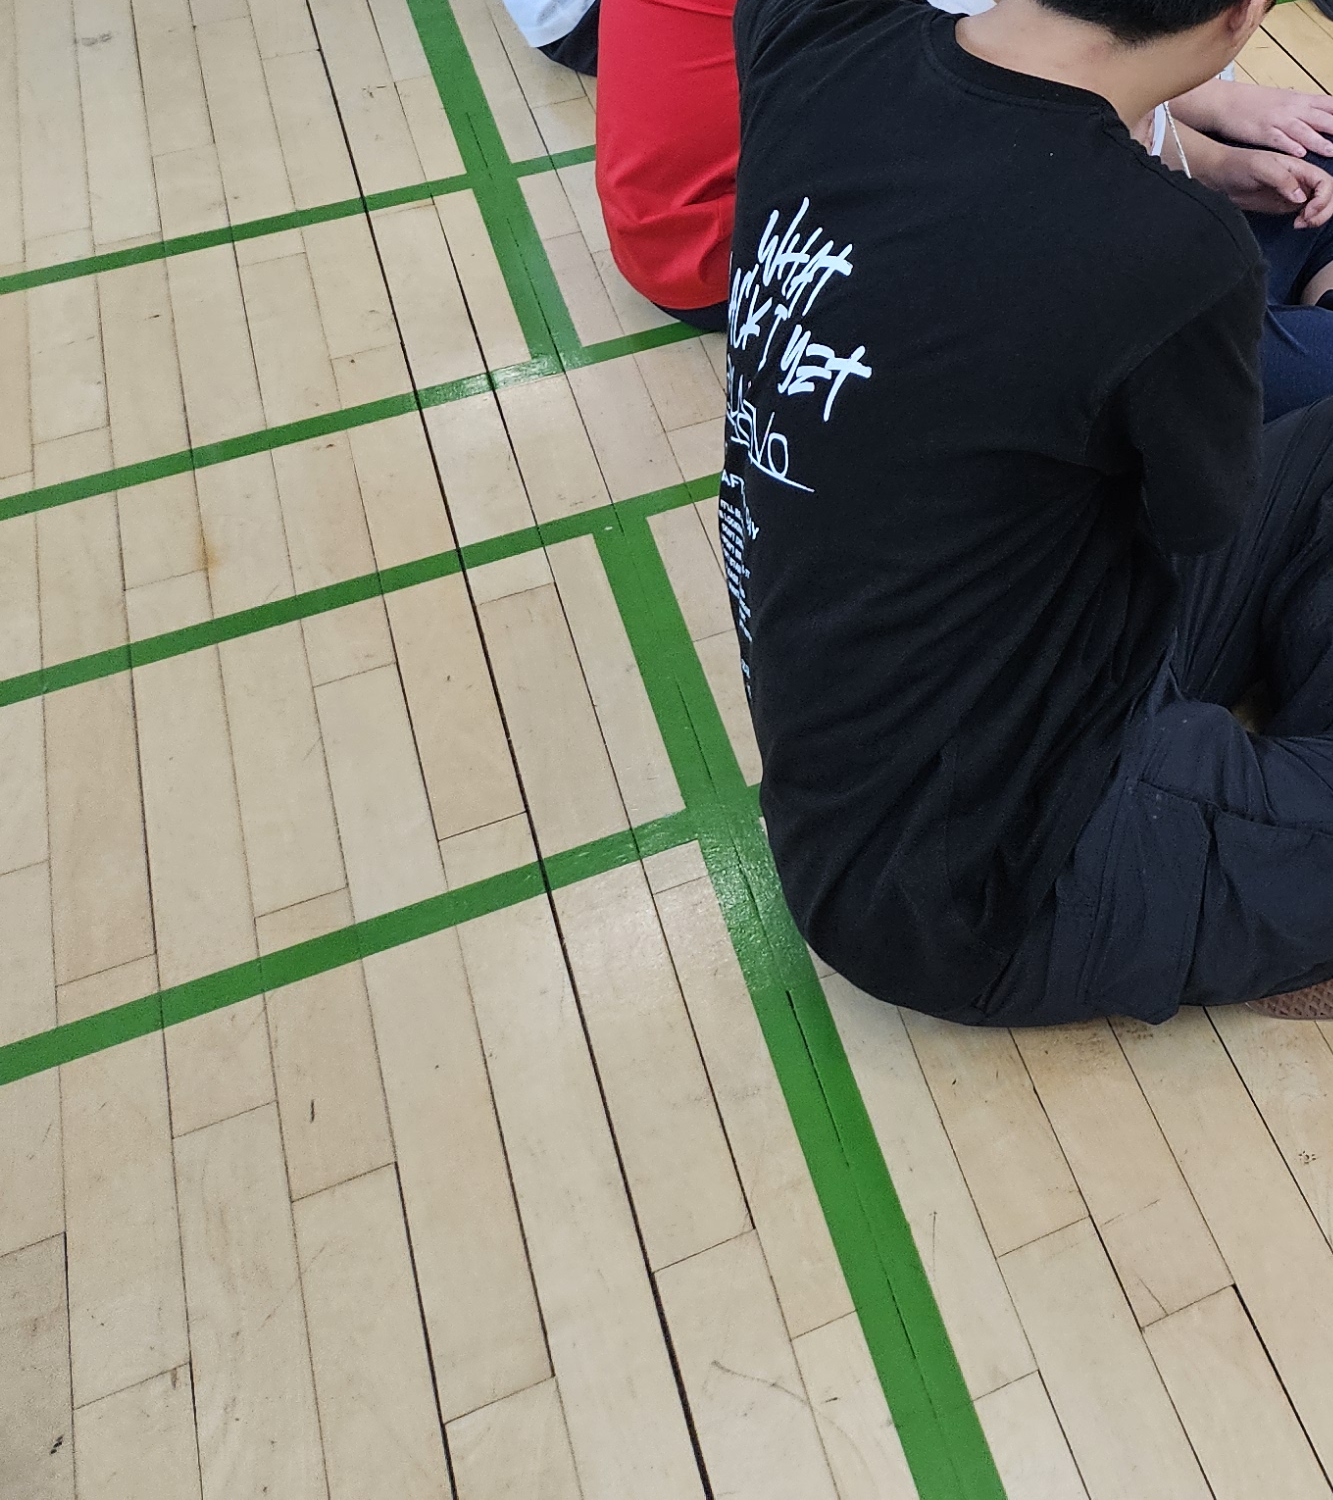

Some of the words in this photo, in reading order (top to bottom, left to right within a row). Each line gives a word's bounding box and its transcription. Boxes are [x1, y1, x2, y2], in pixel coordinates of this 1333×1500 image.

[757, 196, 854, 319] WHAT
[728, 252, 773, 350] ACK
[777, 324, 872, 422] YET
